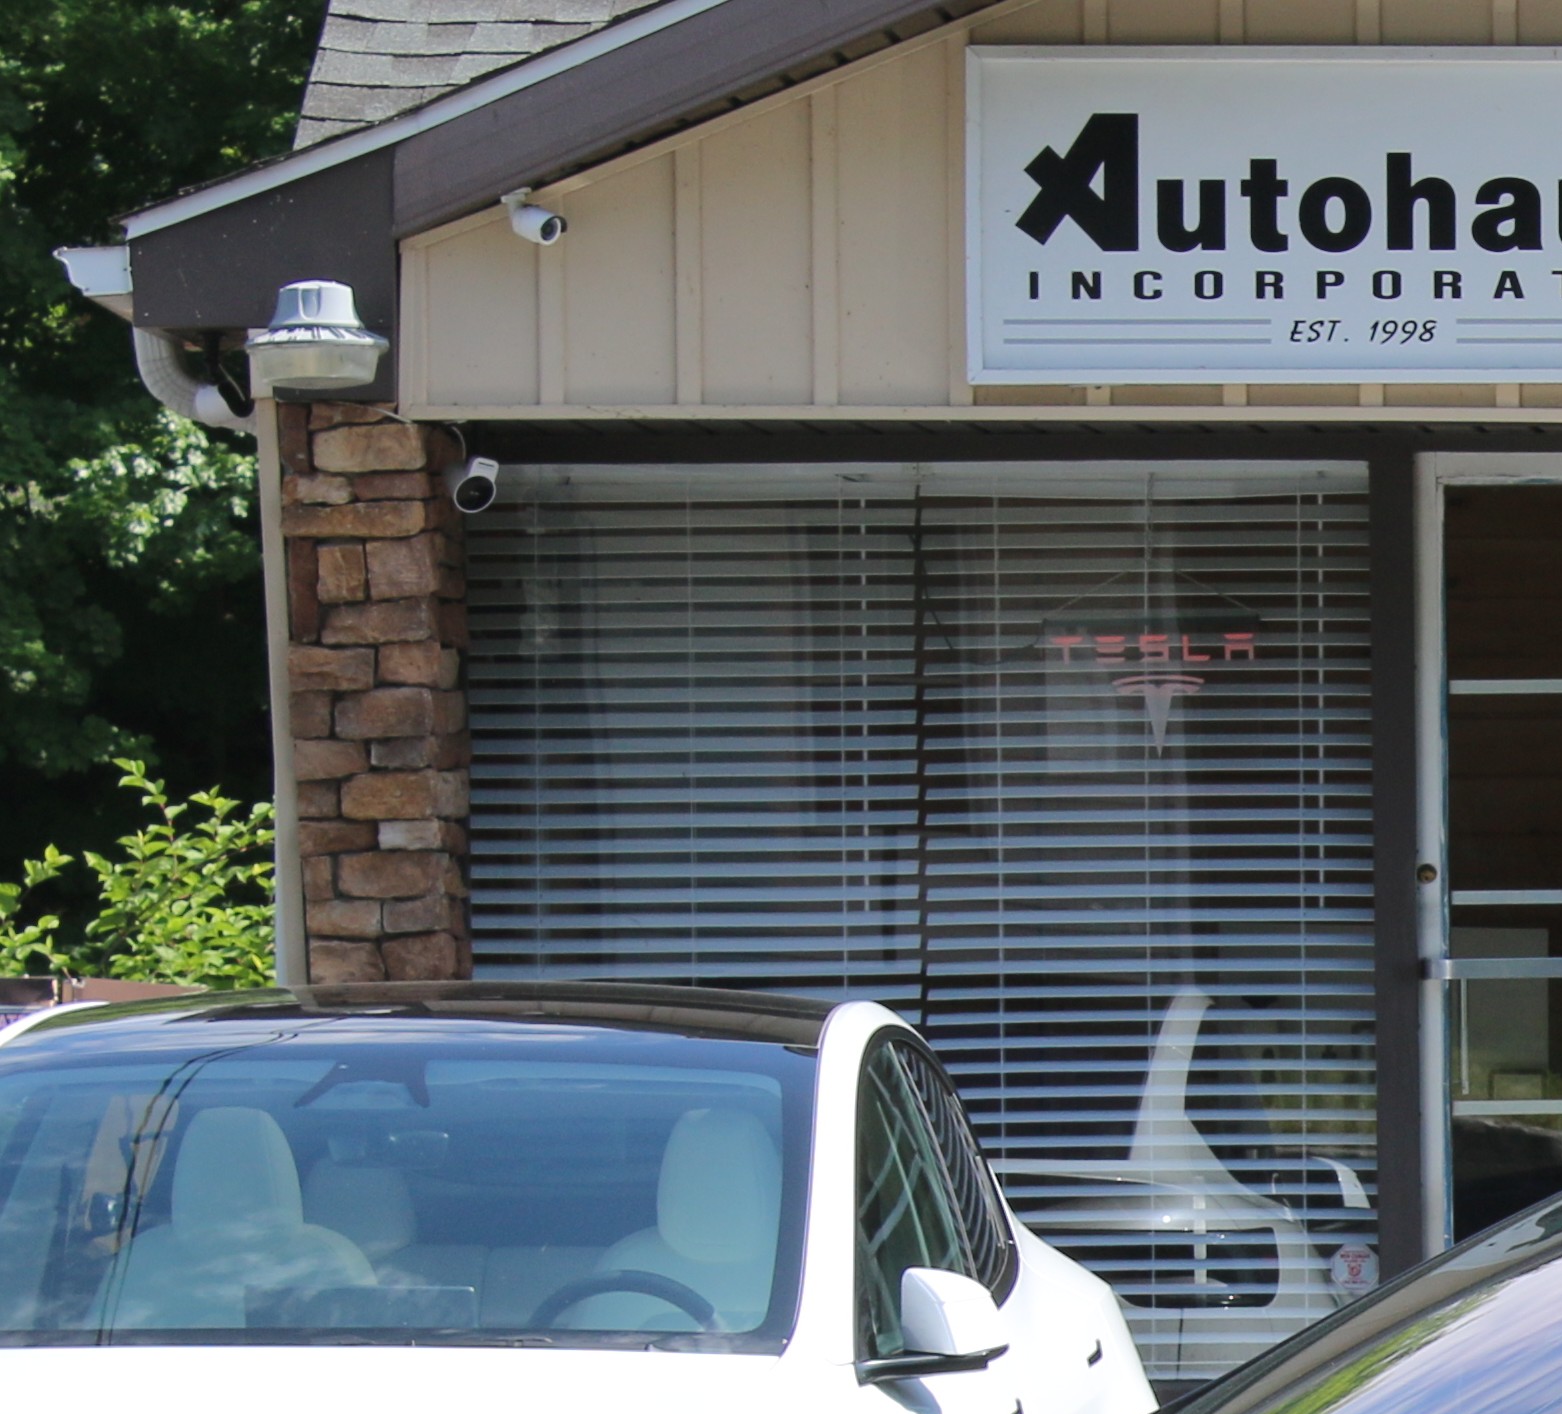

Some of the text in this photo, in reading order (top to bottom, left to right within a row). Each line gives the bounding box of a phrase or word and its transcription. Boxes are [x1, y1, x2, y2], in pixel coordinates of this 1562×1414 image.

[1289, 319, 1438, 345] EST. 1998
[1050, 632, 1255, 666] TESLA
